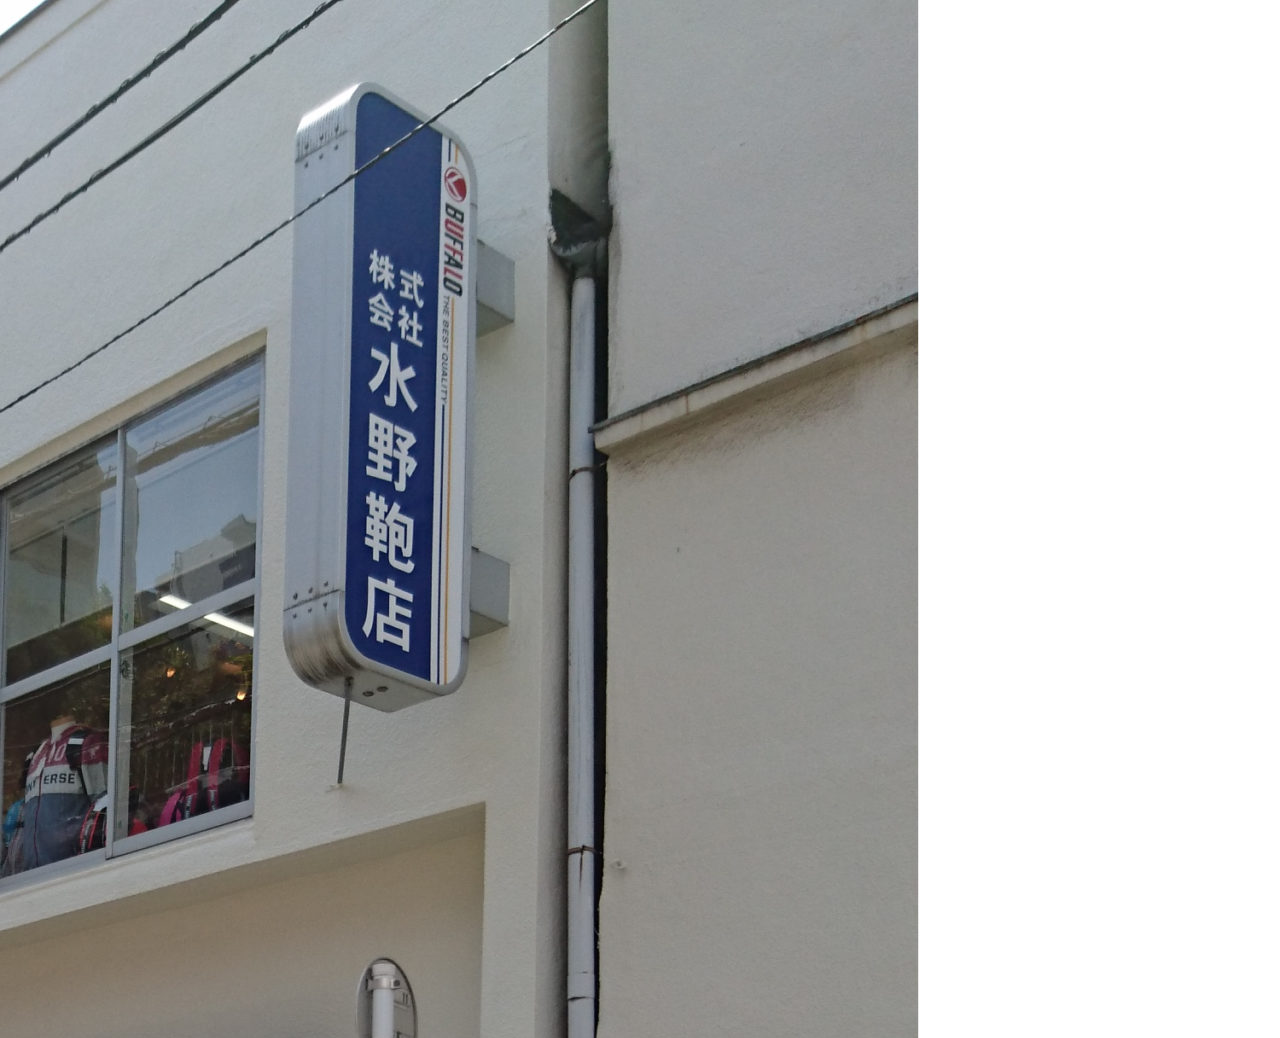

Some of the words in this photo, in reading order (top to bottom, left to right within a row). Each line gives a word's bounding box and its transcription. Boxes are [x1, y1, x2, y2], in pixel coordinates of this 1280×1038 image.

[443, 203, 464, 297] BUFFALO
[442, 321, 450, 350] BEST
[440, 352, 449, 404] QUALITY
[362, 342, 418, 653] 水野鞄店
